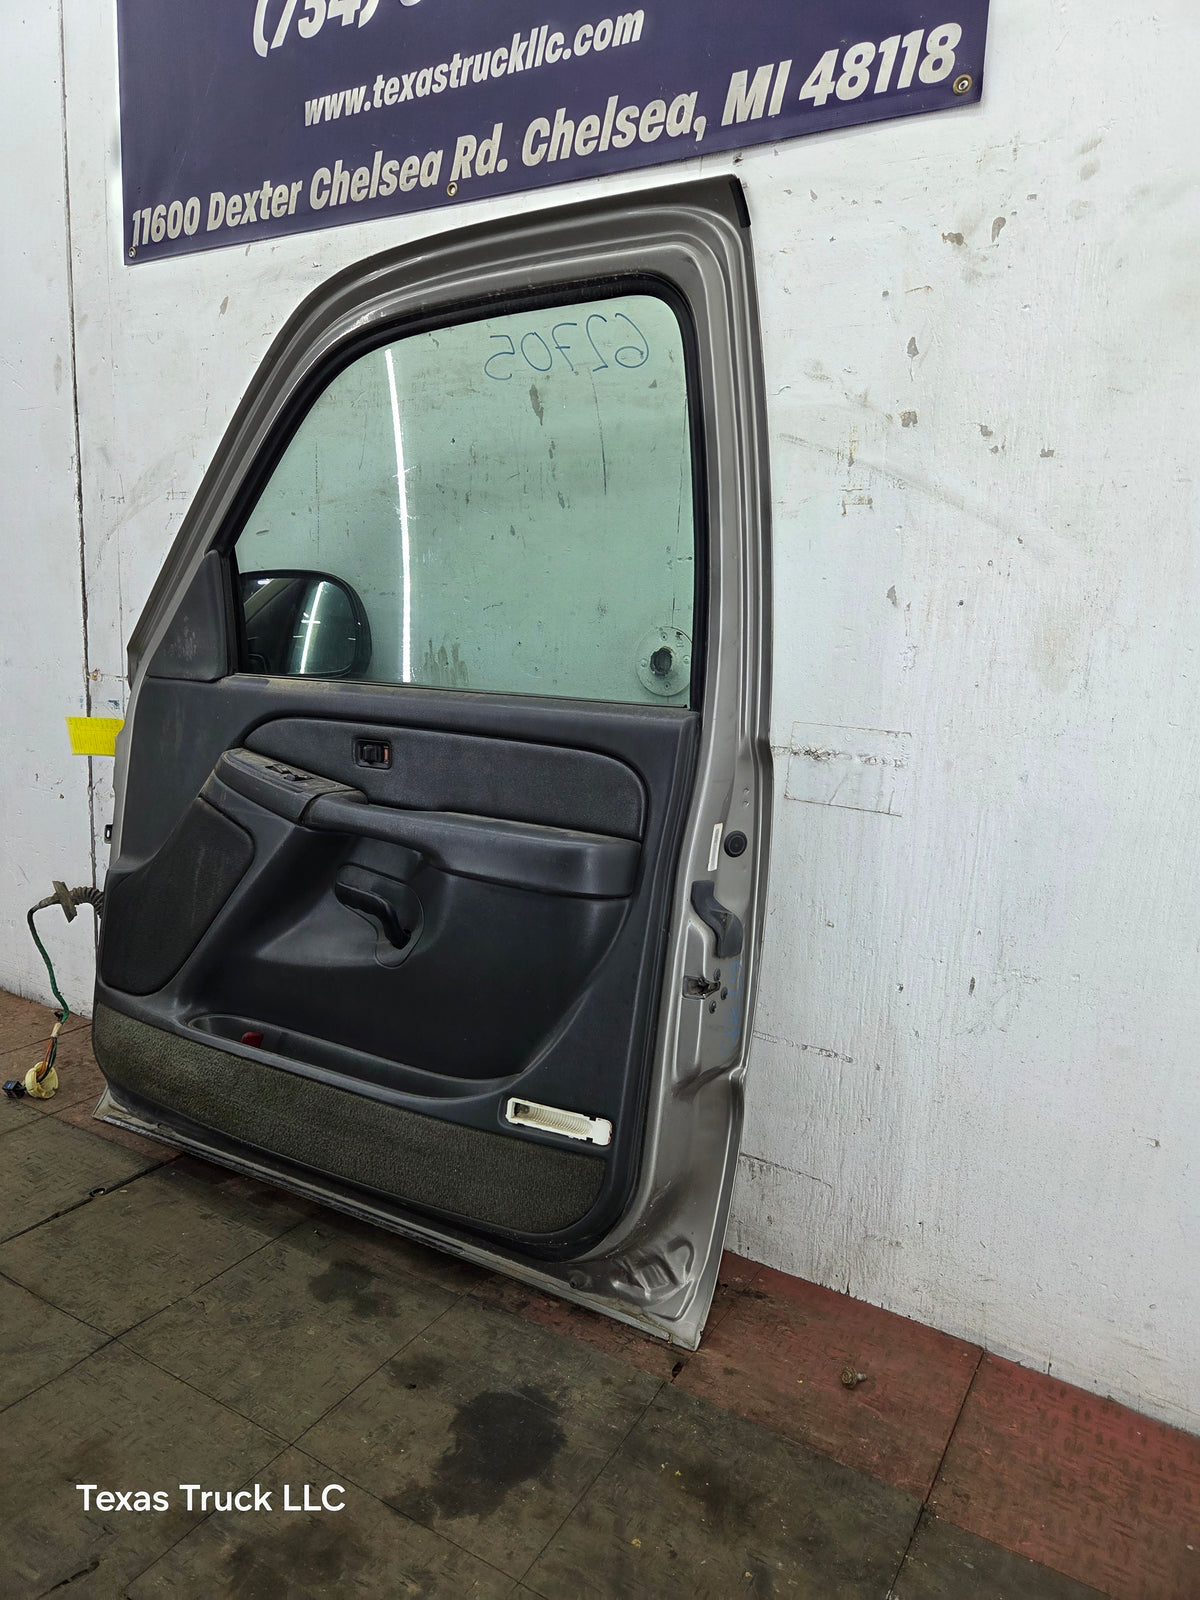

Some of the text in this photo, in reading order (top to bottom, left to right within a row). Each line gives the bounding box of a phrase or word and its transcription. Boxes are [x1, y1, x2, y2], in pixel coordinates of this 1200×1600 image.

[131, 22, 963, 247] 11600 Dexter Chelsea Rd. Chelsea, MI 48118
[305, 9, 645, 126] www.texastruckllc.com
